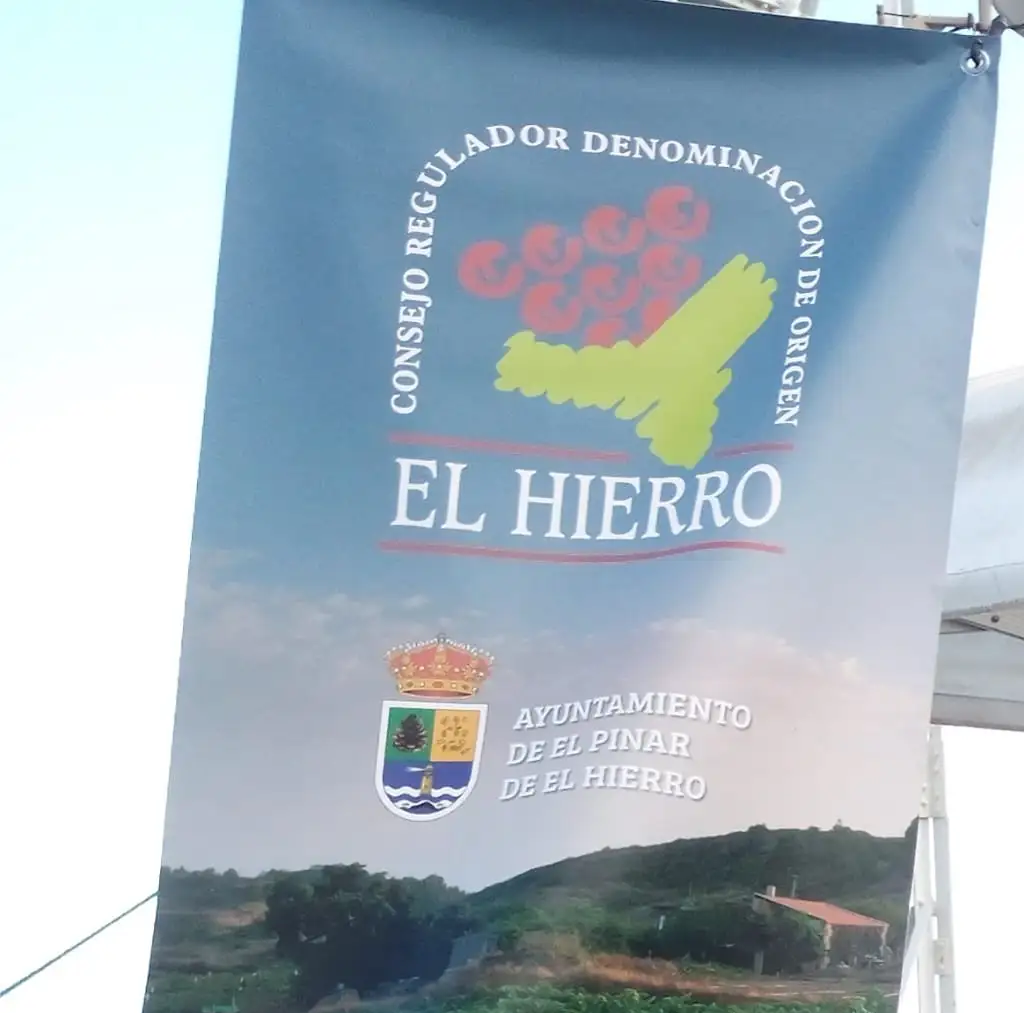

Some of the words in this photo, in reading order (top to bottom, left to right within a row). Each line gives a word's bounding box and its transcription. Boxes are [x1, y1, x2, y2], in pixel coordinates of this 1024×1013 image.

[405, 124, 570, 259] REGULADOR
[581, 130, 824, 259] DENOMINACION
[794, 268, 822, 309] DE
[390, 267, 431, 415] CONSEJO
[774, 315, 813, 428] ORIGEN
[390, 456, 487, 534] EL
[510, 462, 783, 541] HIERRO
[506, 740, 546, 766] DE
[549, 734, 582, 759] EL
[588, 728, 692, 758] PINAR
[512, 692, 753, 730] AYUNTAMIENTO
[498, 774, 538, 801] DE
[542, 768, 575, 794] EL
[581, 764, 708, 801] HIERRO
